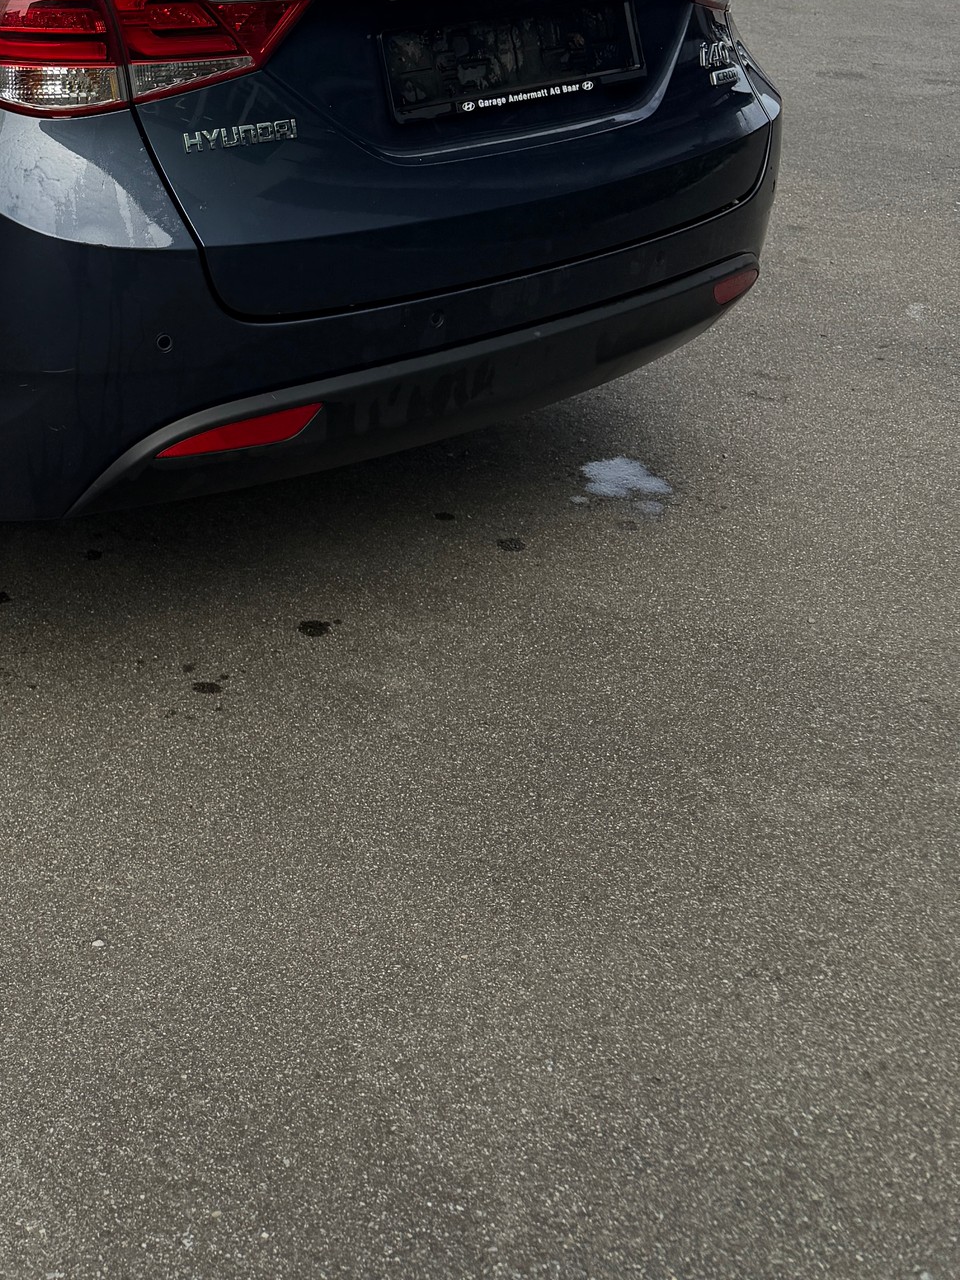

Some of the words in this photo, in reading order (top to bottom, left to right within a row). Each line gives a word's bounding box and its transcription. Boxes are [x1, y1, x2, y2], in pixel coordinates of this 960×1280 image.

[700, 41, 730, 67] i40
[478, 96, 506, 108] Garage
[508, 88, 548, 103] Andermatt
[549, 86, 561, 96] AG
[562, 83, 580, 93] Baar
[183, 118, 297, 154] HYUNDAI
